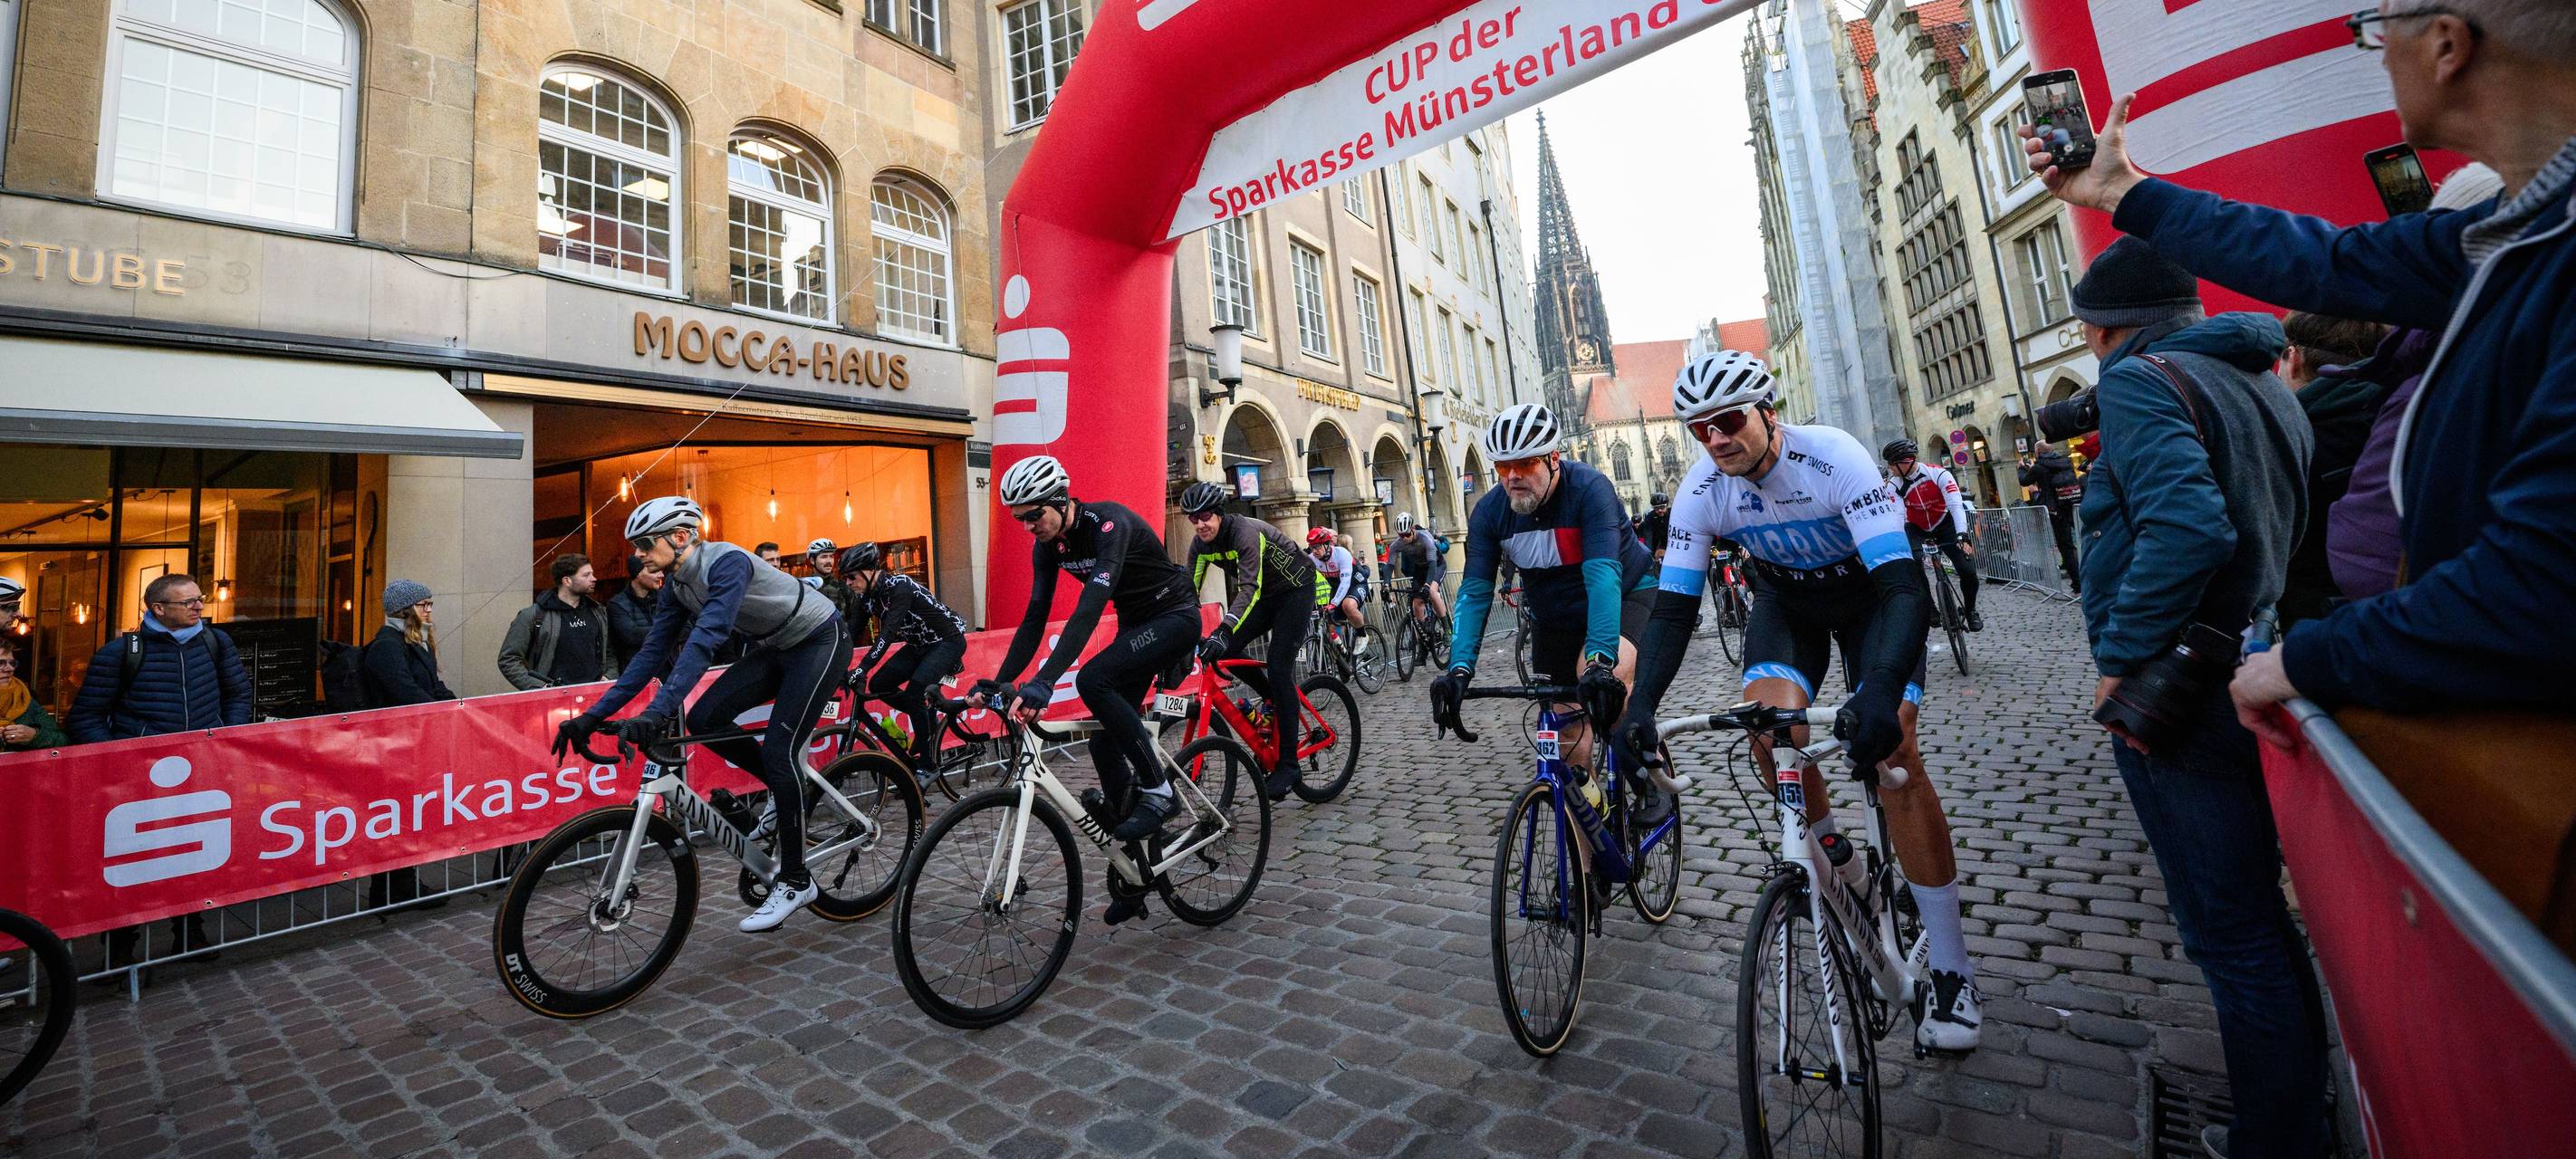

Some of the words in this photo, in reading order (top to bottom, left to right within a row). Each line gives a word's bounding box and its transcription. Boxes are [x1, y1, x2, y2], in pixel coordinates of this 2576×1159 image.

[1365, 41, 1438, 105] CUP
[1449, 5, 1522, 64] der
[1208, 131, 1375, 220] Sparkasse
[1384, 0, 1679, 148] Münsterland
[634, 311, 911, 390] MOCCA-HAUS
[1788, 450, 1807, 464] DT
[1808, 455, 1834, 477] SWISS
[1129, 628, 1158, 653] ROSE
[1164, 696, 1184, 713] 1284
[258, 763, 619, 867] Sparkasse
[675, 783, 745, 859] CANYON
[505, 953, 523, 972] DT
[514, 974, 548, 1004] SWISS
